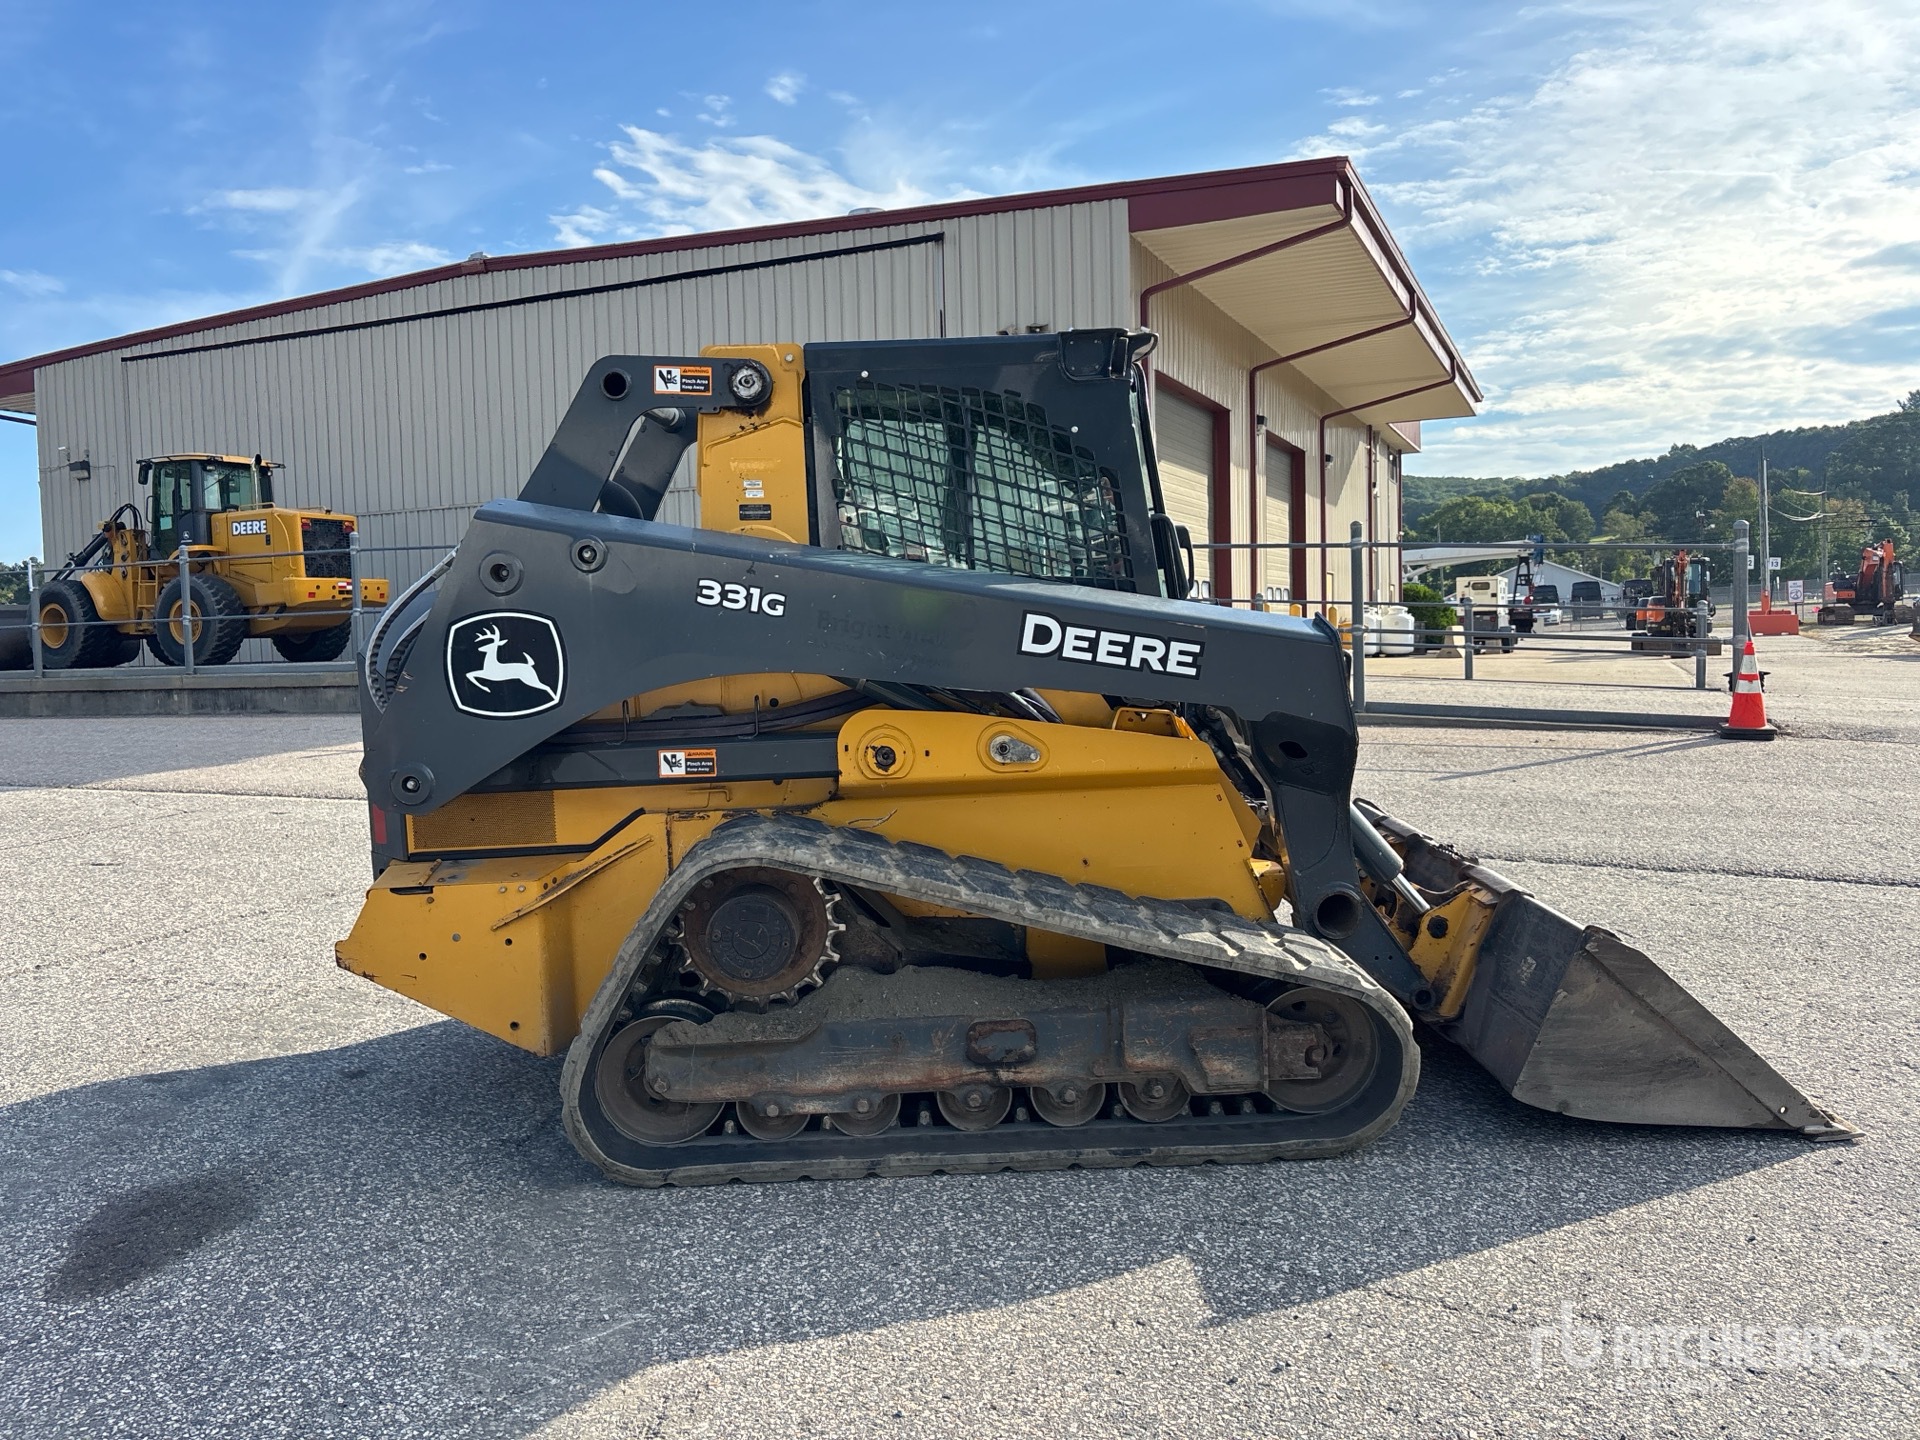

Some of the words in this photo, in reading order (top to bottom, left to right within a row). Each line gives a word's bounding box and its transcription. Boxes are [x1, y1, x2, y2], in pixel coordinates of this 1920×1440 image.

[232, 520, 267, 535] DEERE
[696, 579, 786, 616] 331G
[1021, 613, 1201, 676] DEERE
